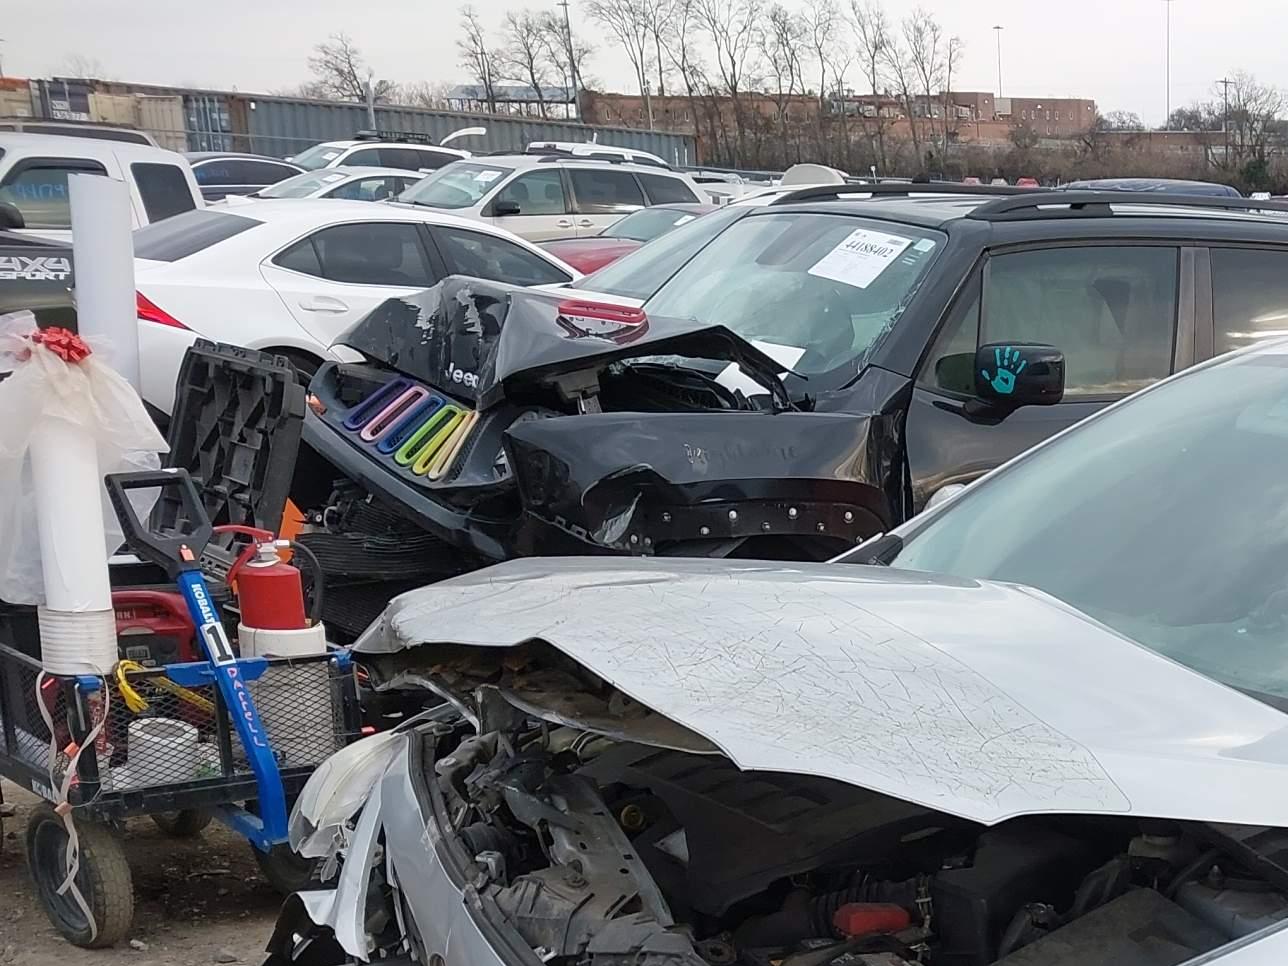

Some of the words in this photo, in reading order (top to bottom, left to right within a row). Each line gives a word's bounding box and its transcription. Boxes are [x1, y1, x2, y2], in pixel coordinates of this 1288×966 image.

[0, 271, 70, 280] SPORT
[191, 583, 216, 625] KOBALT
[206, 625, 233, 662] 1
